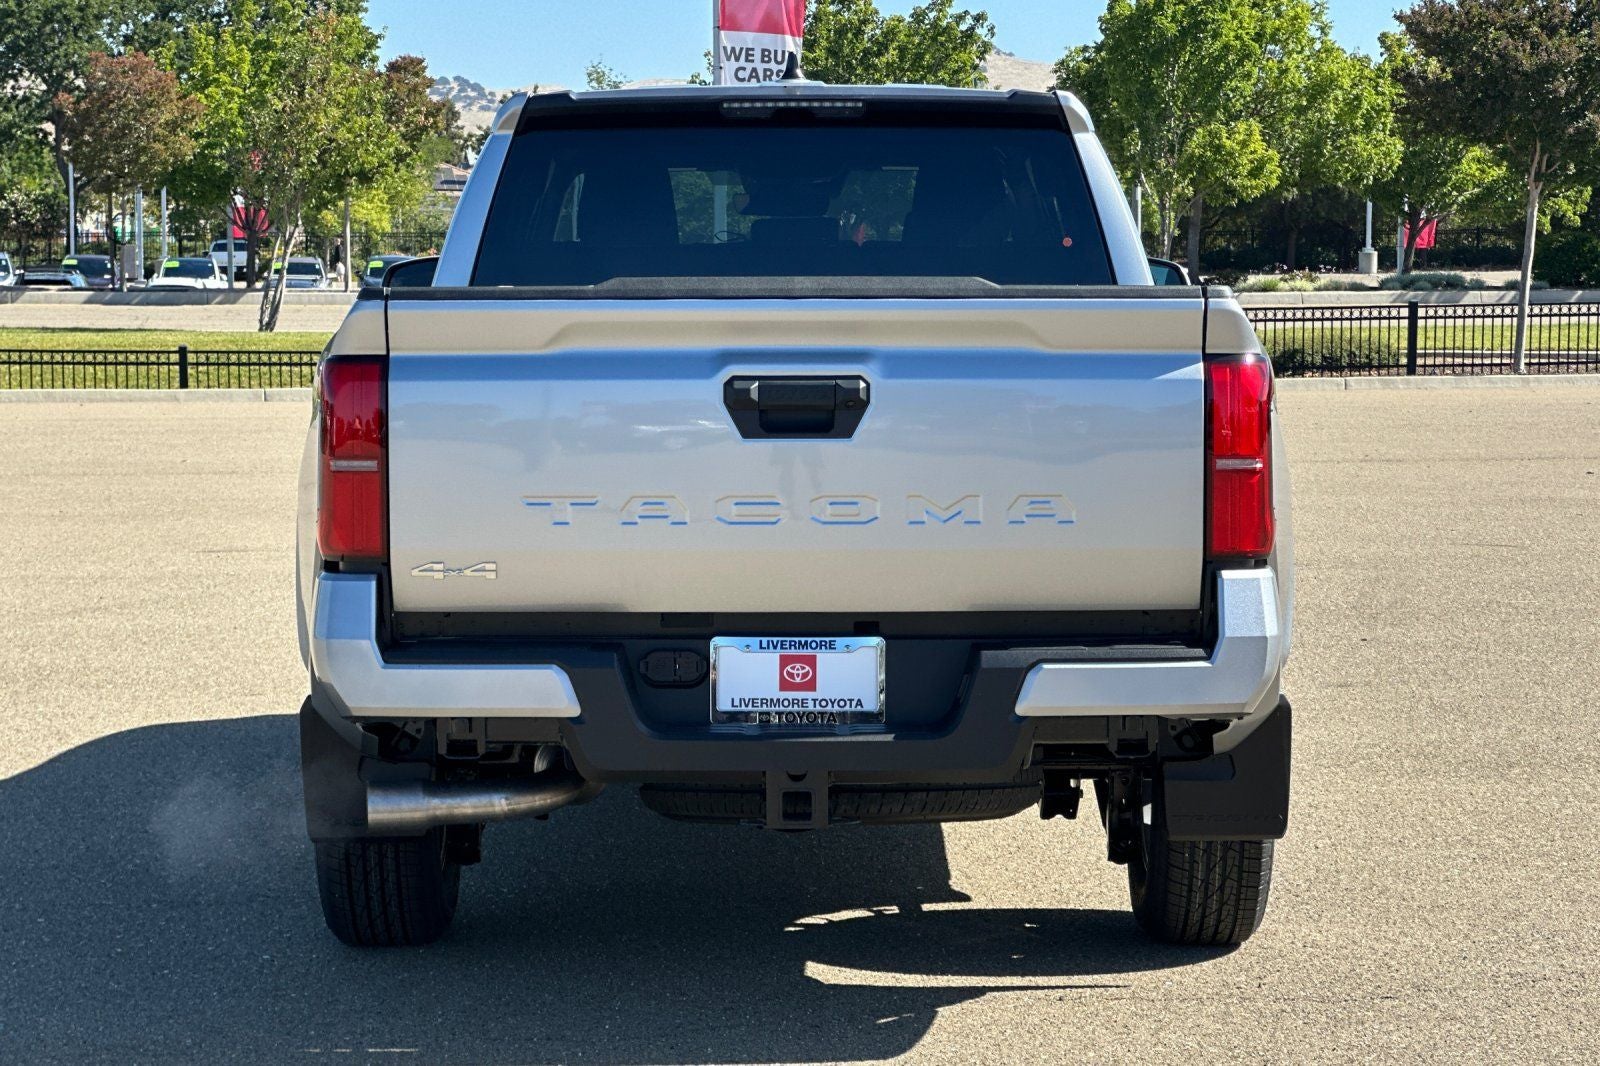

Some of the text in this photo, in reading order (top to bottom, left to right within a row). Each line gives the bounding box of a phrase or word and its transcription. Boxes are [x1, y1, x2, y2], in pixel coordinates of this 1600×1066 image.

[722, 46, 790, 65] WE BU
[522, 495, 1076, 526] TACOMA
[758, 639, 837, 651] LIVERMORE
[731, 697, 864, 709] LIVERMORE TOYOTA
[777, 711, 838, 724] TOYOTA
